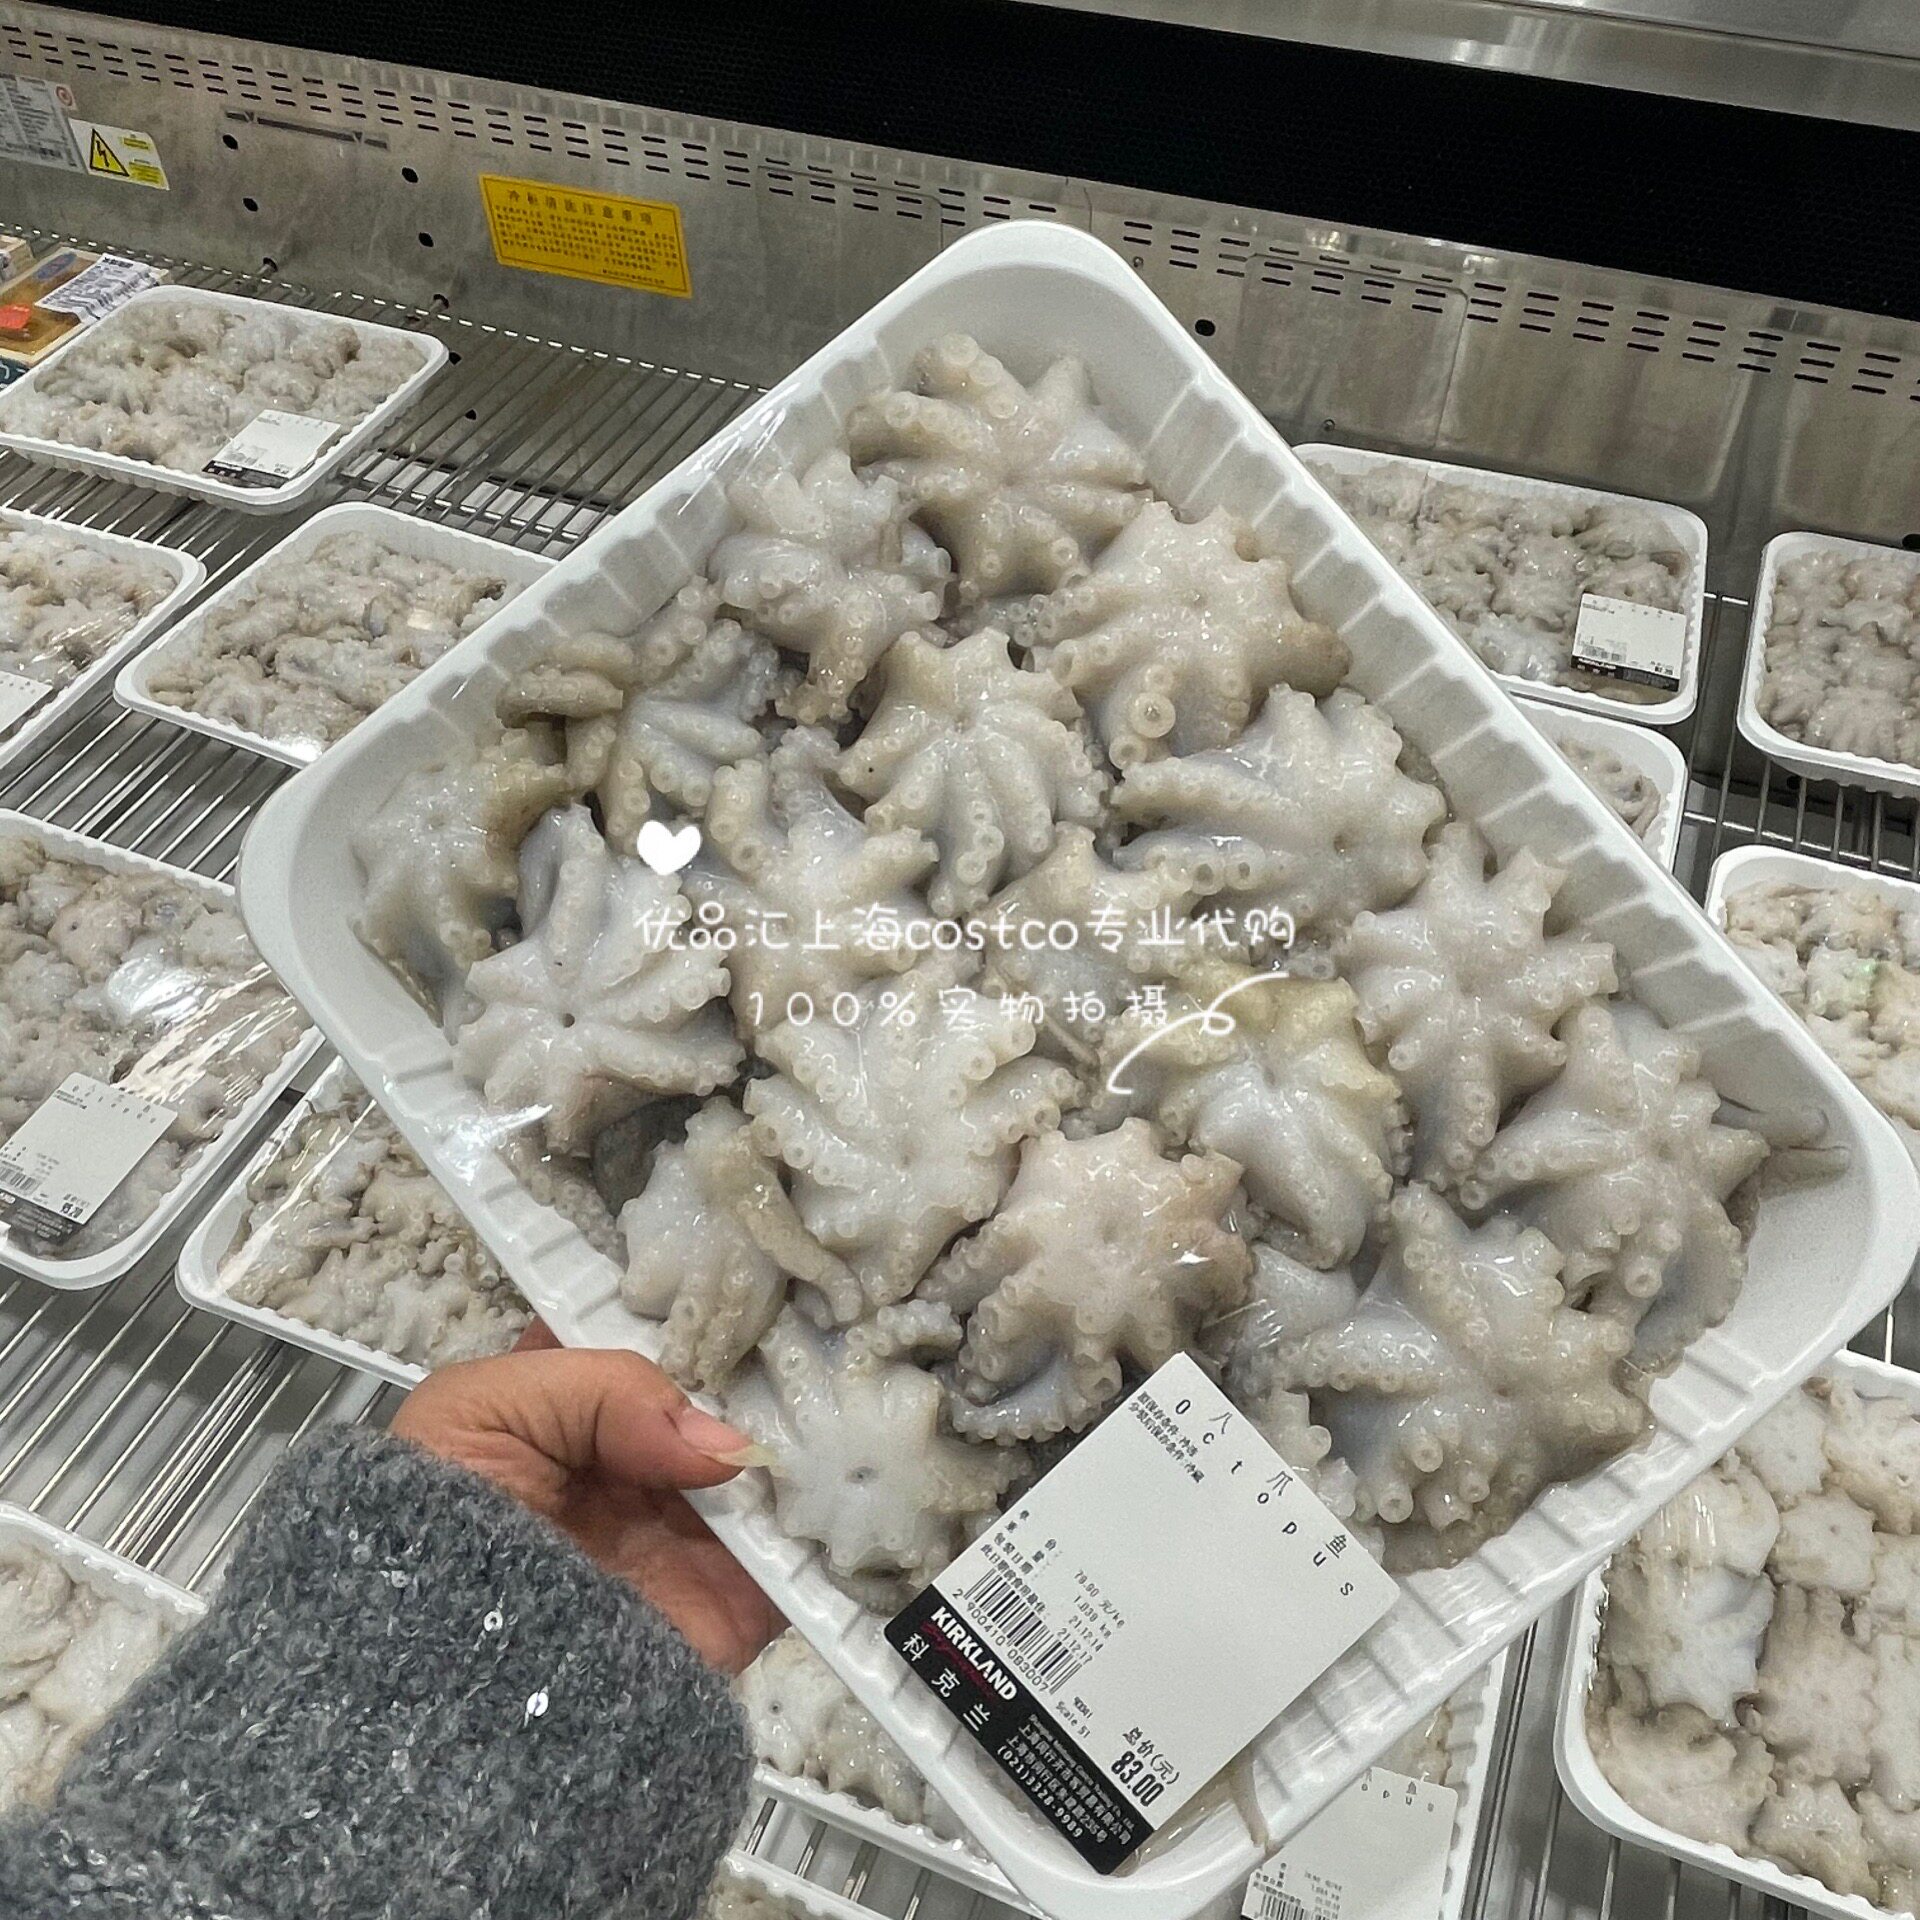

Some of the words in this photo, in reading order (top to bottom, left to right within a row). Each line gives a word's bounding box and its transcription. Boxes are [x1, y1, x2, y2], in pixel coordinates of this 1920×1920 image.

[1174, 1398, 1354, 1596] Octopus
[1207, 1410, 1347, 1559] 八爪鱼
[901, 1632, 990, 1731] 科克兰
[929, 1605, 1017, 1700] KIRKLAND
[1110, 1749, 1165, 1807] 83.00
[1121, 1725, 1180, 1785] 总价(元)
